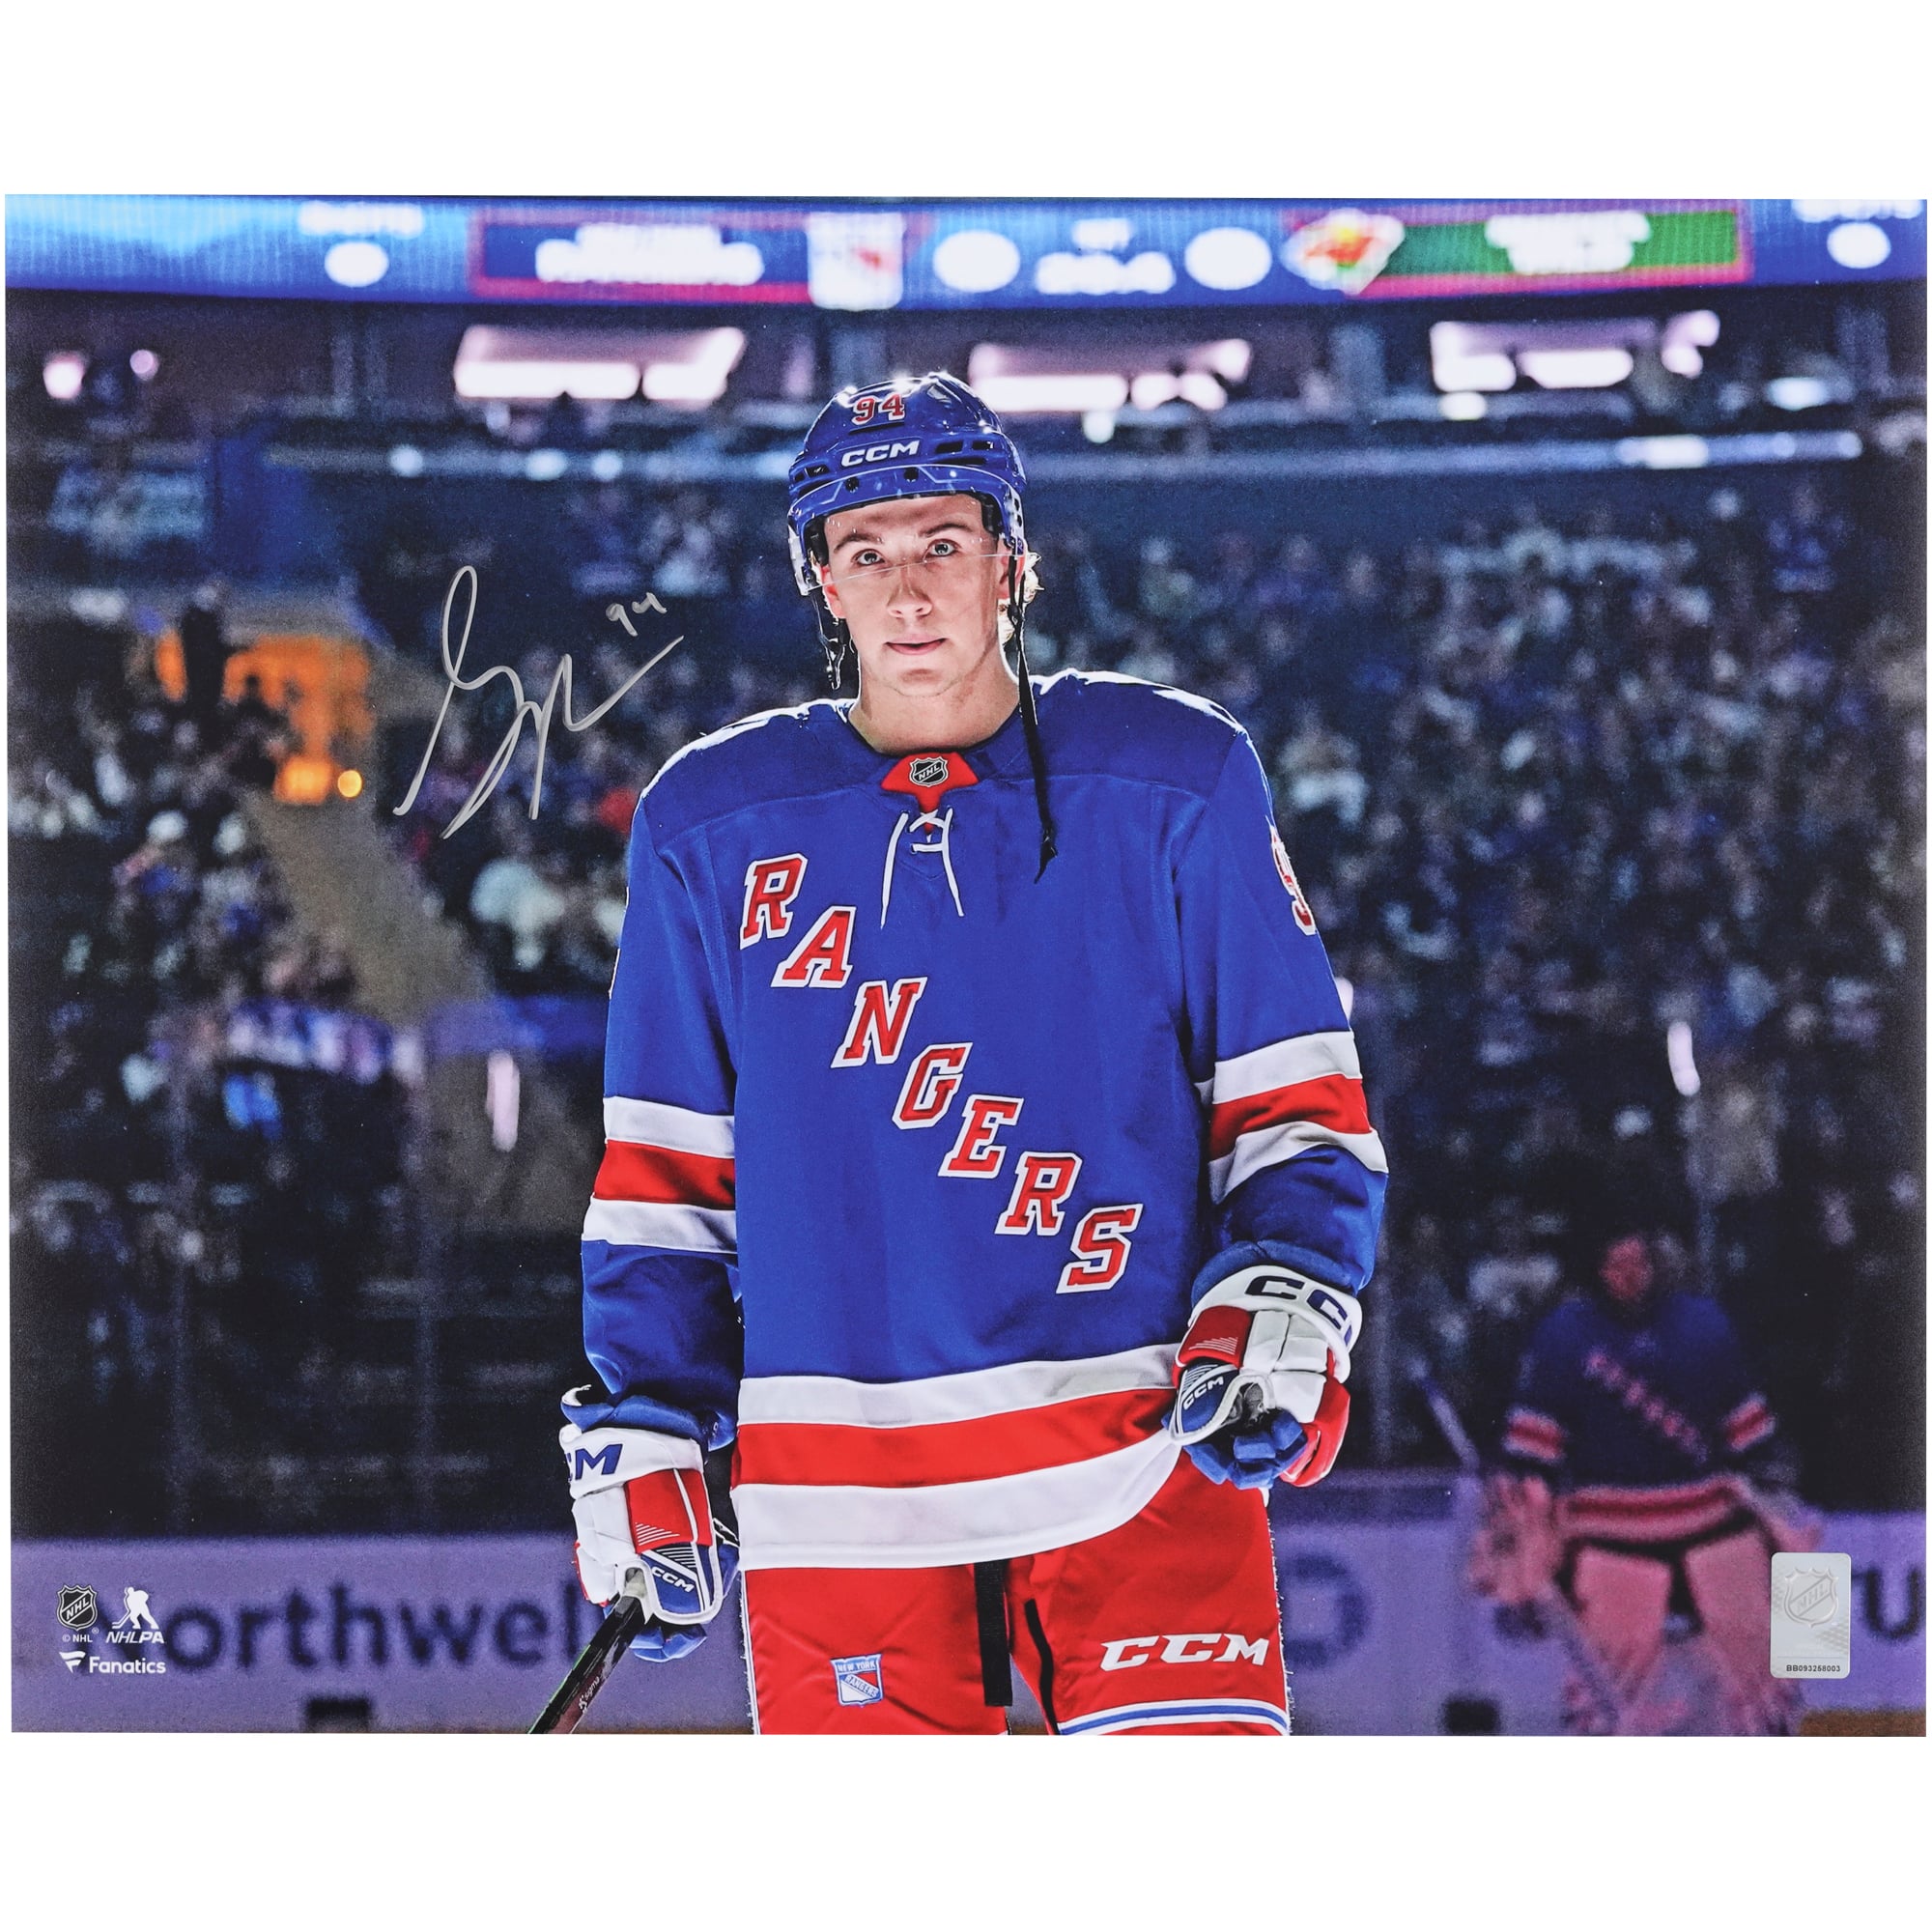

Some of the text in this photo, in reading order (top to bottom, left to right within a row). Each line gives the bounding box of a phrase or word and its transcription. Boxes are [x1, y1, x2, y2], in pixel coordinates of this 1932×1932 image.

[852, 393, 906, 425] 94
[840, 440, 920, 468] CCM
[740, 852, 1143, 1294] RANGERS
[1244, 1275, 1353, 1347] CC
[1182, 1377, 1225, 1410] CCM
[651, 1566, 695, 1593] CCM
[1101, 1633, 1268, 1672] CCM
